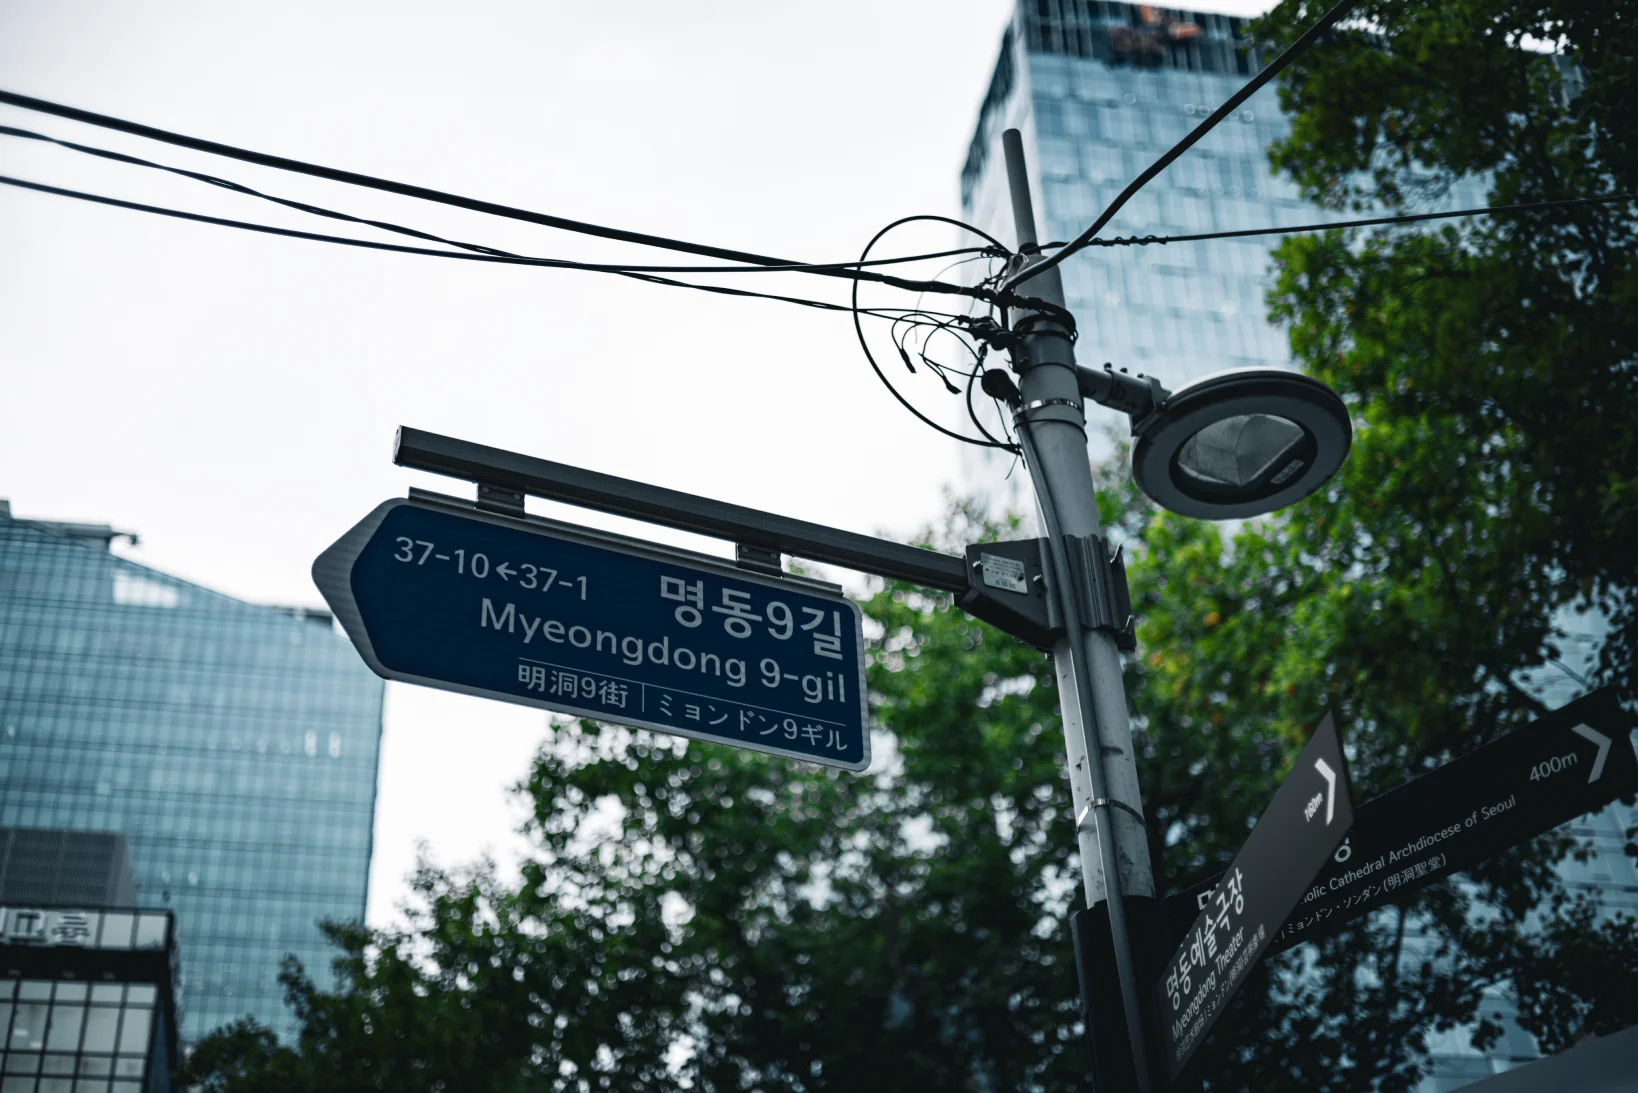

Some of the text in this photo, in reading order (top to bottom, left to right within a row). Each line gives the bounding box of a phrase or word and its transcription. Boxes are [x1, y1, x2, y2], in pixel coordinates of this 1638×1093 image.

[394, 536, 588, 601] 37-10 37-1
[480, 598, 846, 704] Myeongdong 9-gil
[660, 575, 844, 661] 명동9길
[518, 664, 628, 709] 明洞9街
[659, 693, 848, 752] ミョンドン9ギル
[1529, 752, 1578, 781] 400m
[1329, 859, 1386, 891] Cathedral
[1389, 823, 1462, 861] Archdiocese
[1465, 814, 1478, 828] of
[1481, 794, 1517, 820] Seoul
[1166, 867, 1245, 1010] 명동예술극장
[1172, 926, 1244, 1042] Myeongdong Theater
